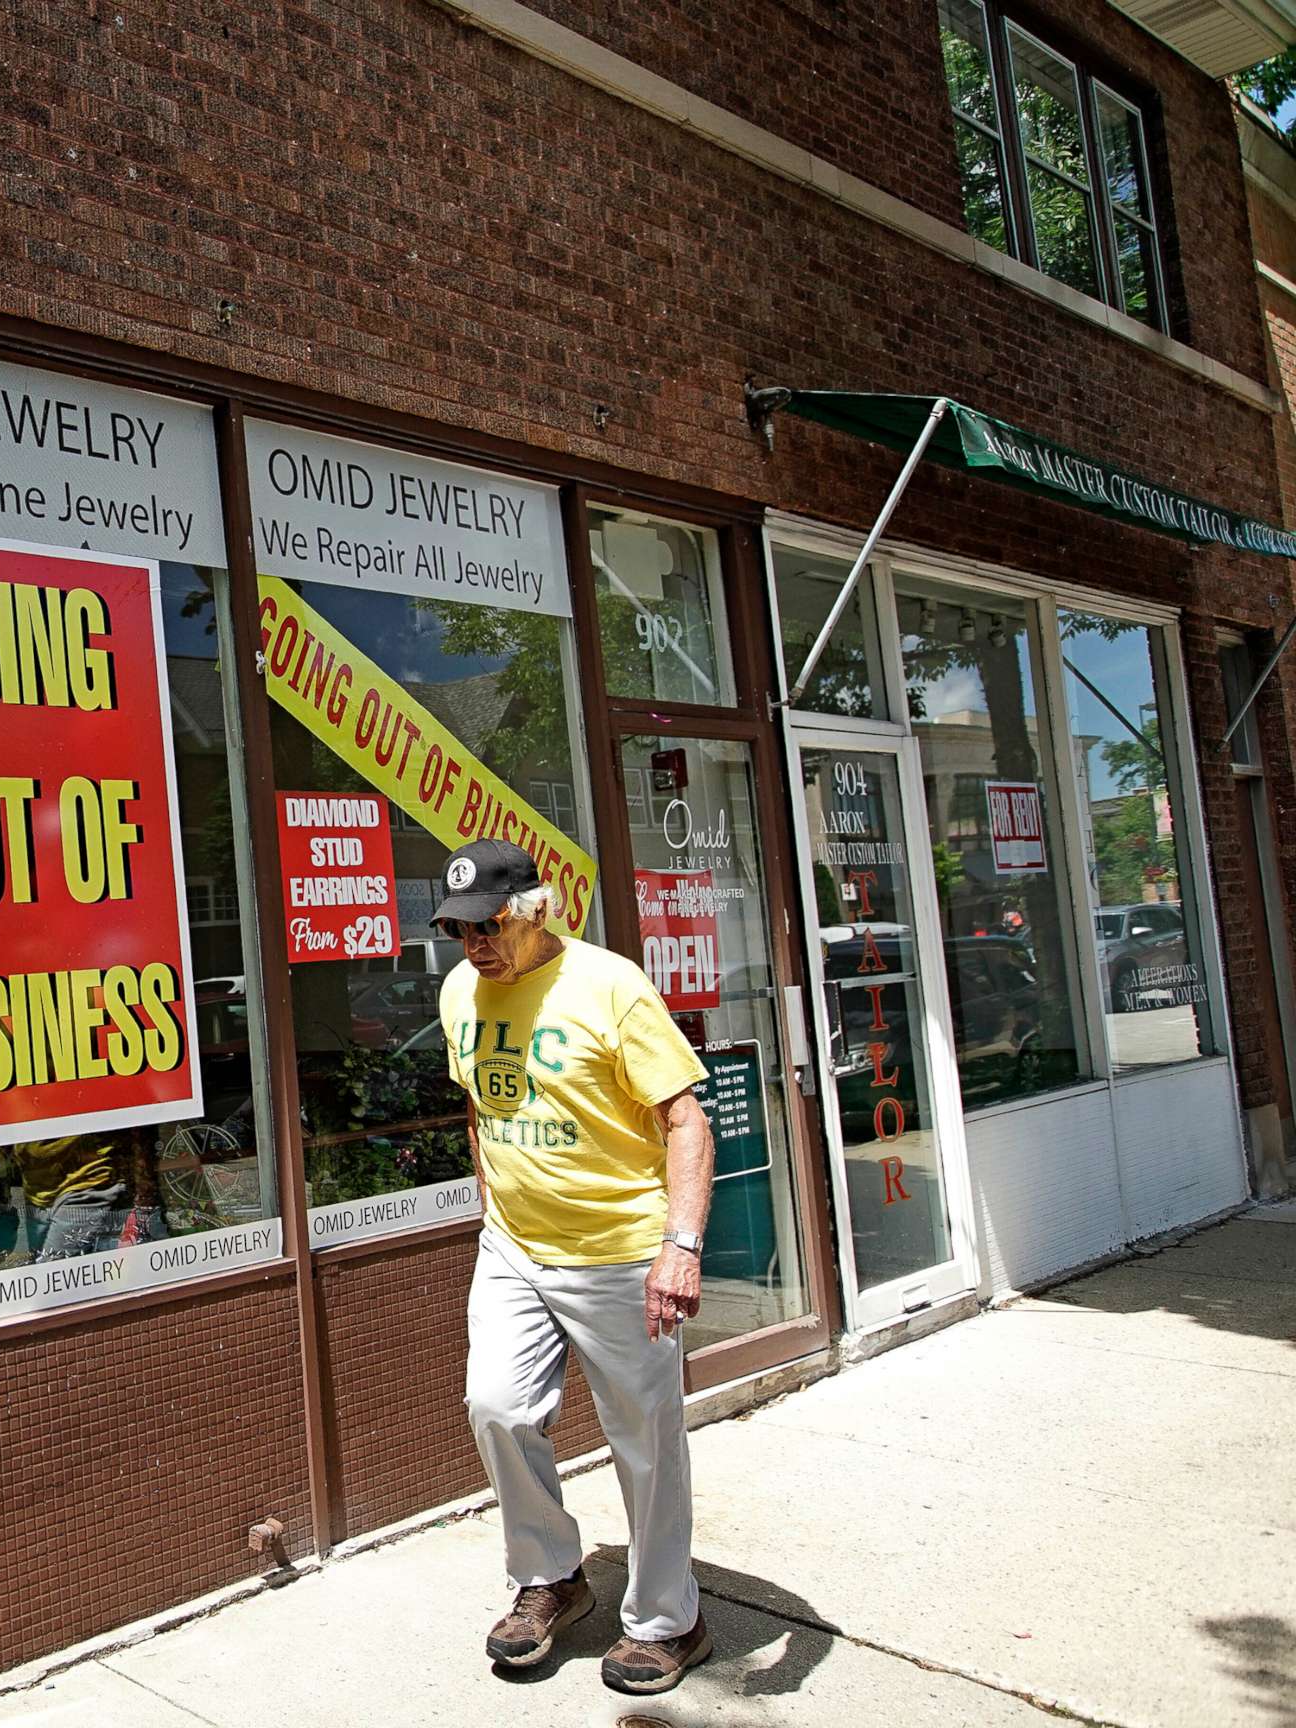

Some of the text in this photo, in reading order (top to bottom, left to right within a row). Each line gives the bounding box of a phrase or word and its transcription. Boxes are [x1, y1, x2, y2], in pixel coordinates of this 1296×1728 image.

[268, 448, 527, 541] OMID JEWELRY
[1034, 444, 1111, 504] MASTER
[1111, 474, 1179, 528] CUSTOM
[1177, 501, 1237, 546] TAILOR
[57, 482, 194, 553] Jewelry
[259, 517, 544, 607] We Repair All Jewelry
[258, 596, 354, 730] GOING
[354, 687, 422, 782] OUT
[418, 743, 462, 815] OF
[835, 762, 868, 796] 904
[285, 797, 381, 829] DIAMOND
[663, 799, 730, 849] Omid
[819, 811, 867, 835] AARON
[990, 791, 1040, 837] FOR RENT
[59, 775, 144, 905] OF
[310, 836, 365, 867] STUD
[817, 842, 905, 865] MASTER CUSTOM TAILOR
[669, 856, 732, 870] JEWELRY
[289, 875, 389, 907] EARRINGS
[656, 889, 670, 901] WE
[289, 915, 394, 959] From $29
[644, 935, 716, 995] OPEN
[1124, 992, 1152, 1012] MEN
[1167, 984, 1208, 1006] WOMEN
[705, 1039, 733, 1053] HOURS:
[489, 1072, 518, 1098] 65
[721, 1062, 750, 1074] Appointment
[313, 1196, 418, 1236] OMID JEWELRY
[436, 1186, 472, 1210] OMID
[148, 1228, 273, 1273] OMID JEWELRY
[42, 1257, 125, 1299] JEWELRY
